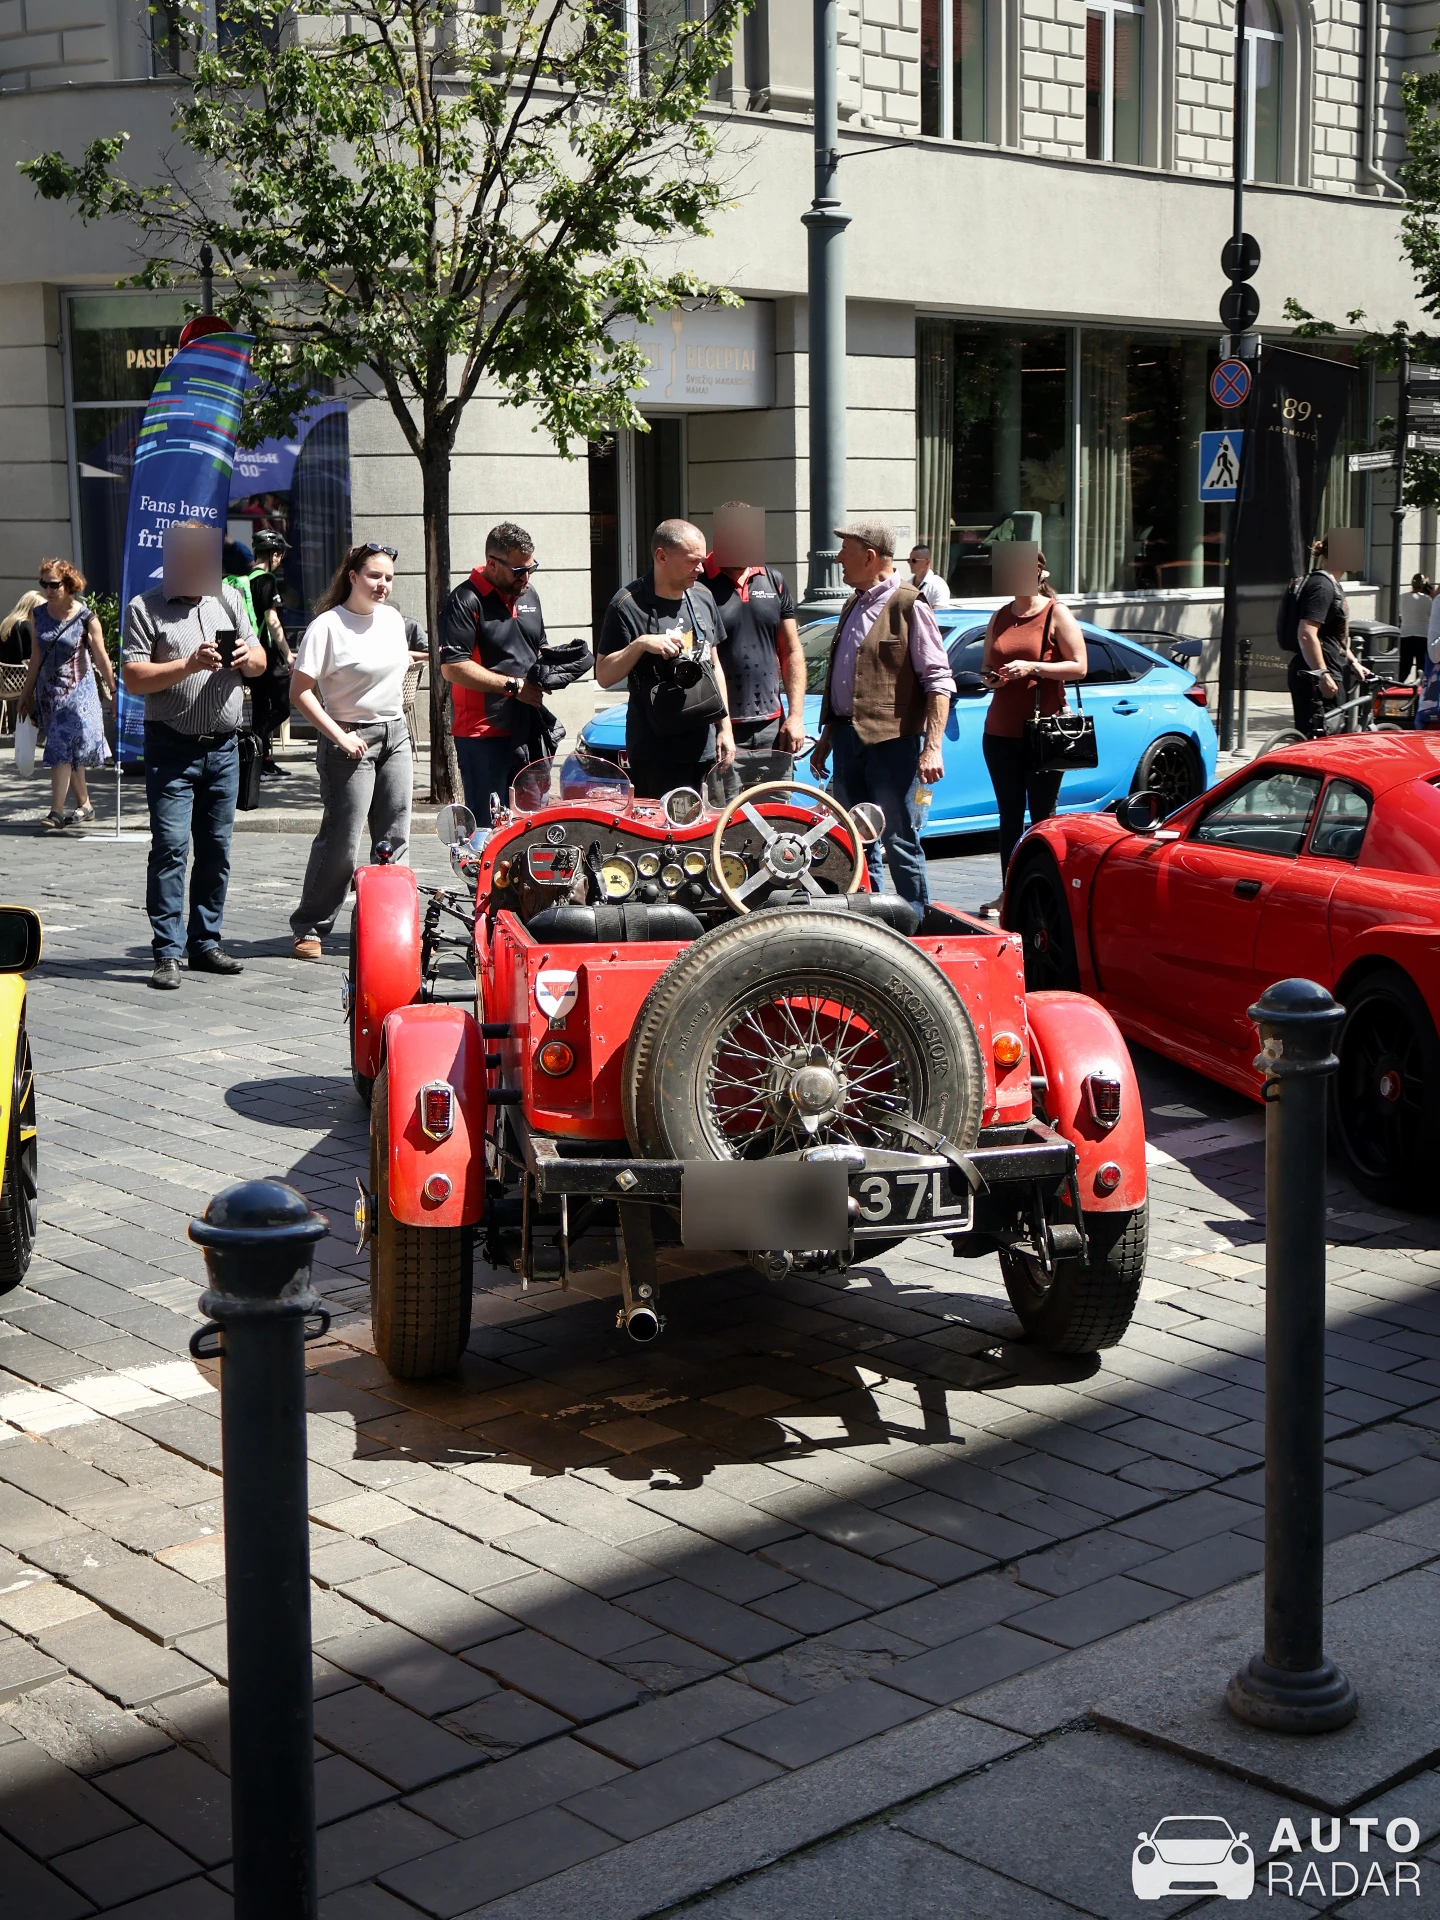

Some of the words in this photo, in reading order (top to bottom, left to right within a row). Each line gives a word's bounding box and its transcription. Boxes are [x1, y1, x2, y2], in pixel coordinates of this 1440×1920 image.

[127, 344, 179, 369] PASLĖ
[686, 345, 756, 371] RECEPTAI
[1283, 398, 1312, 421] 89
[1268, 425, 1318, 441] AROMATIC
[139, 495, 176, 514] Fans
[179, 500, 218, 519] have
[884, 974, 949, 1078] EXCELSIOR
